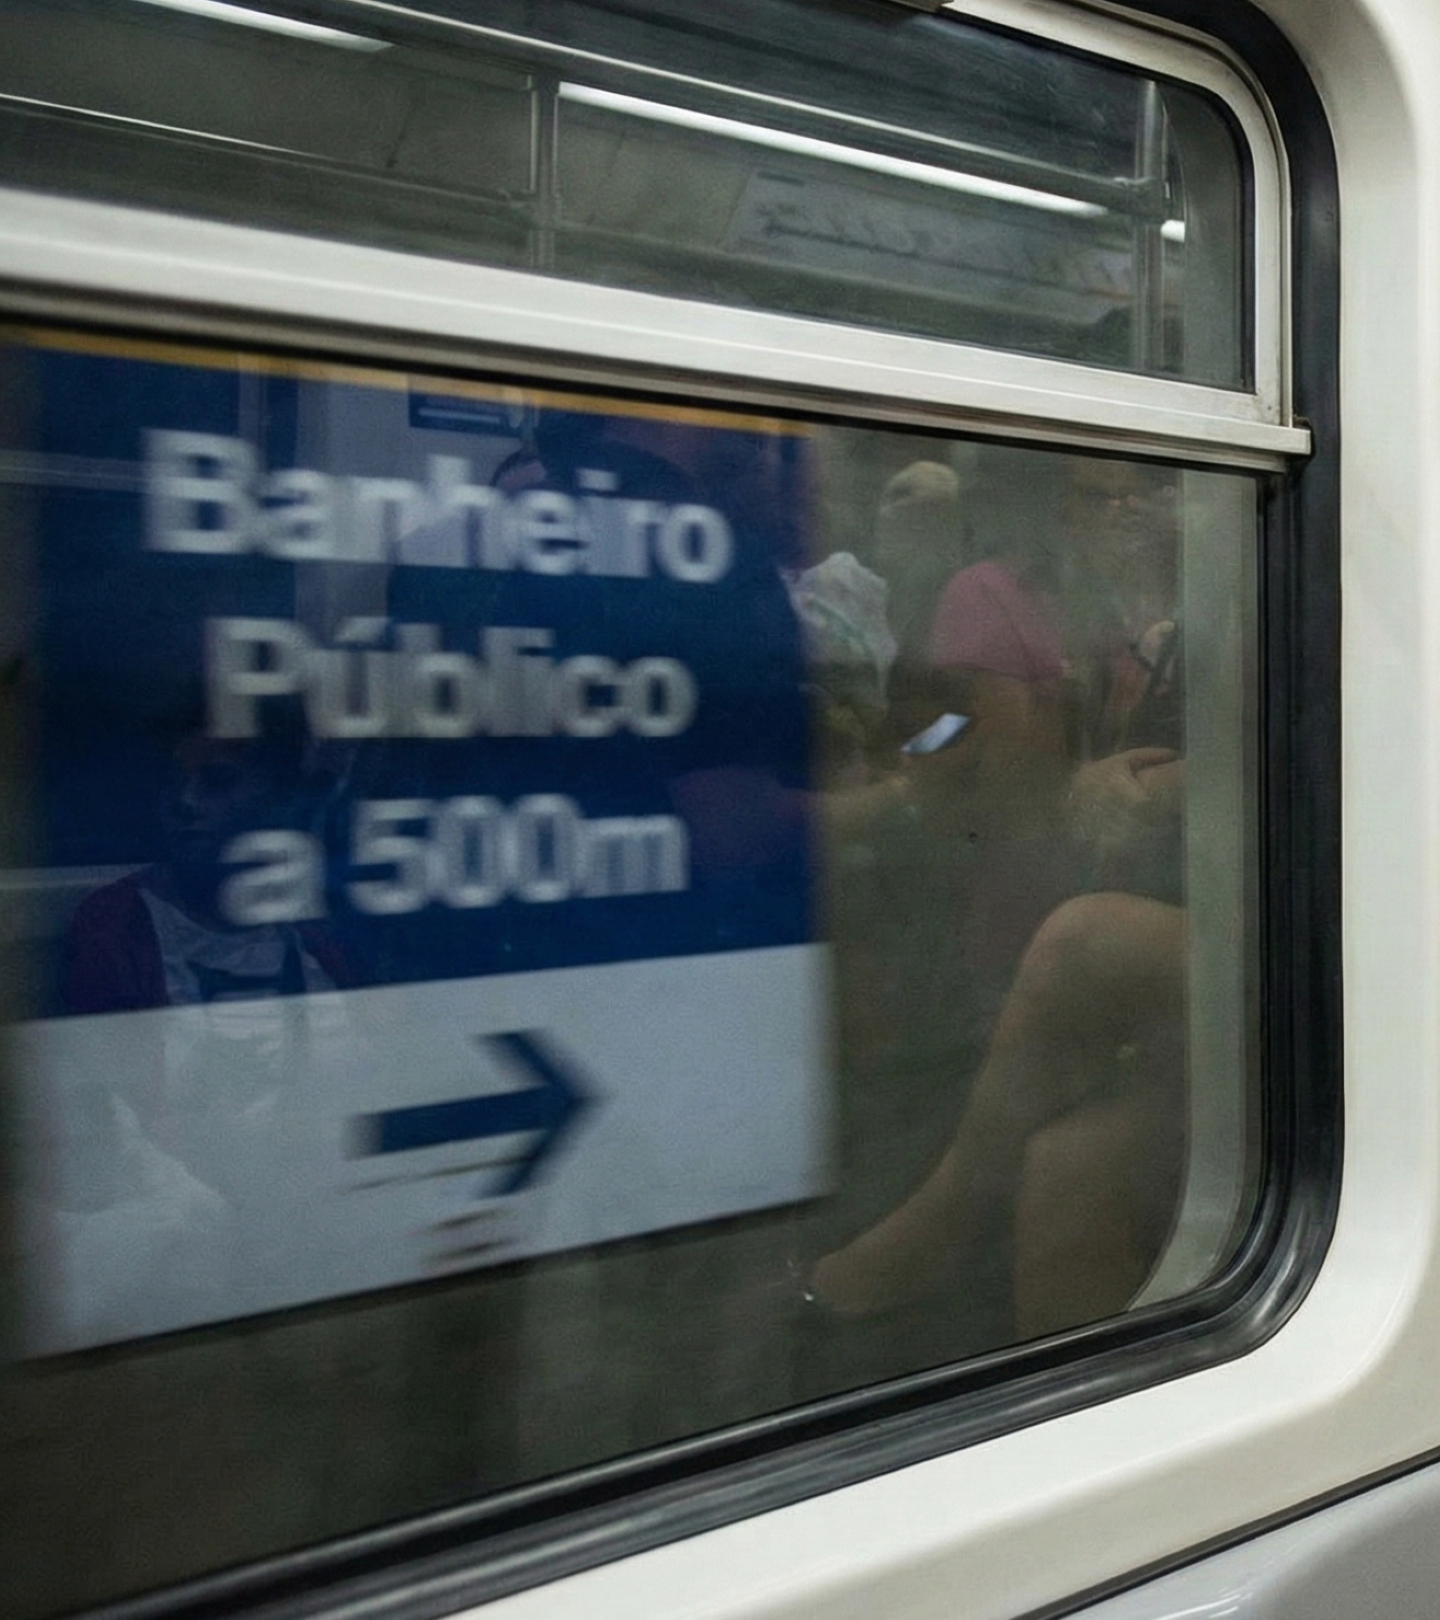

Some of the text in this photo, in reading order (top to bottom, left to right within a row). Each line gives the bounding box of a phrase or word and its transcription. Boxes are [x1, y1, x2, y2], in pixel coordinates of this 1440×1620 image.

[145, 430, 732, 582] Banheiro
[208, 617, 697, 737] Público
[221, 796, 689, 924] a 500m
